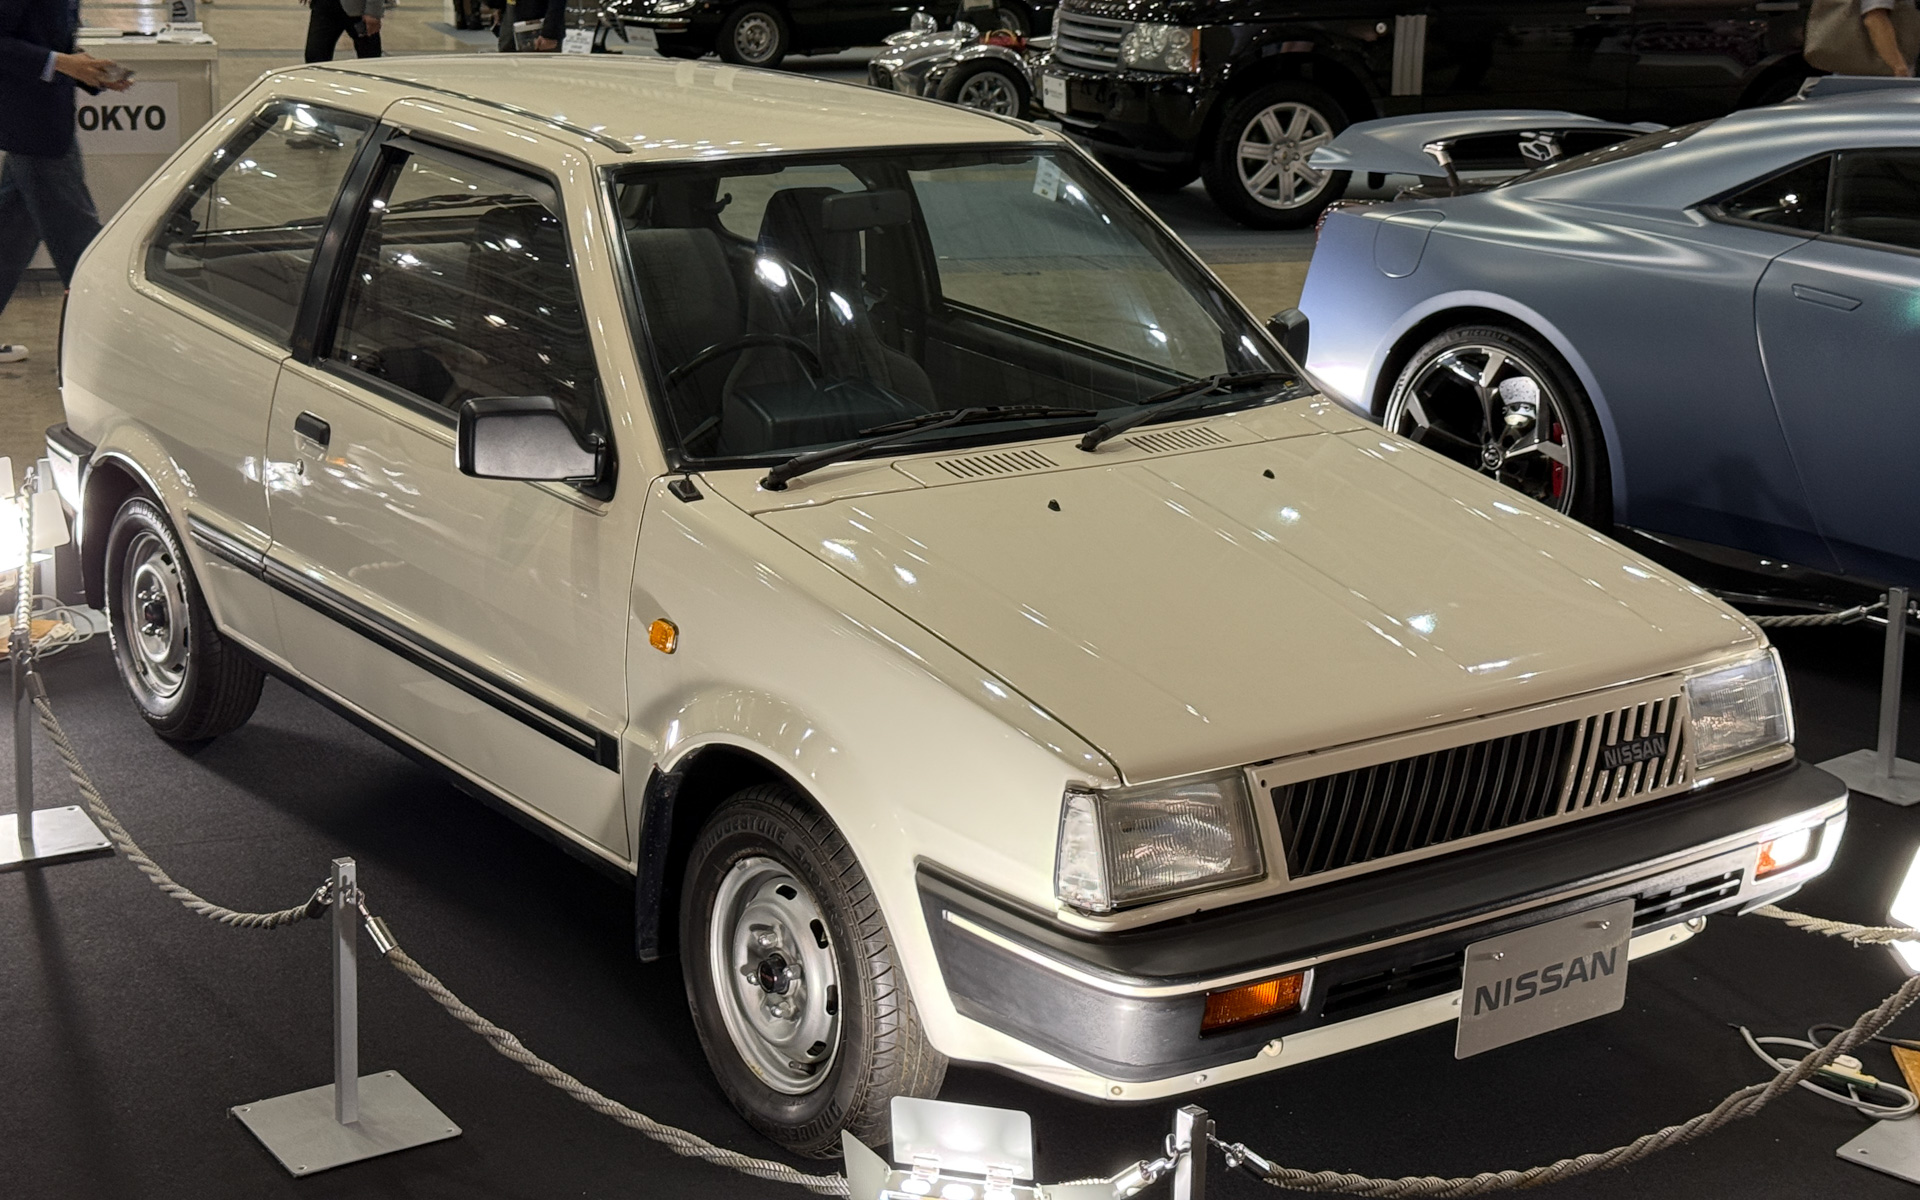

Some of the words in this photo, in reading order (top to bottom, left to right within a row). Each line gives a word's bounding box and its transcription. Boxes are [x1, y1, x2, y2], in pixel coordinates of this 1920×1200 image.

[77, 105, 166, 131] OKYO
[1603, 737, 1667, 768] NISSAN
[1474, 946, 1617, 1016] NISSAN
